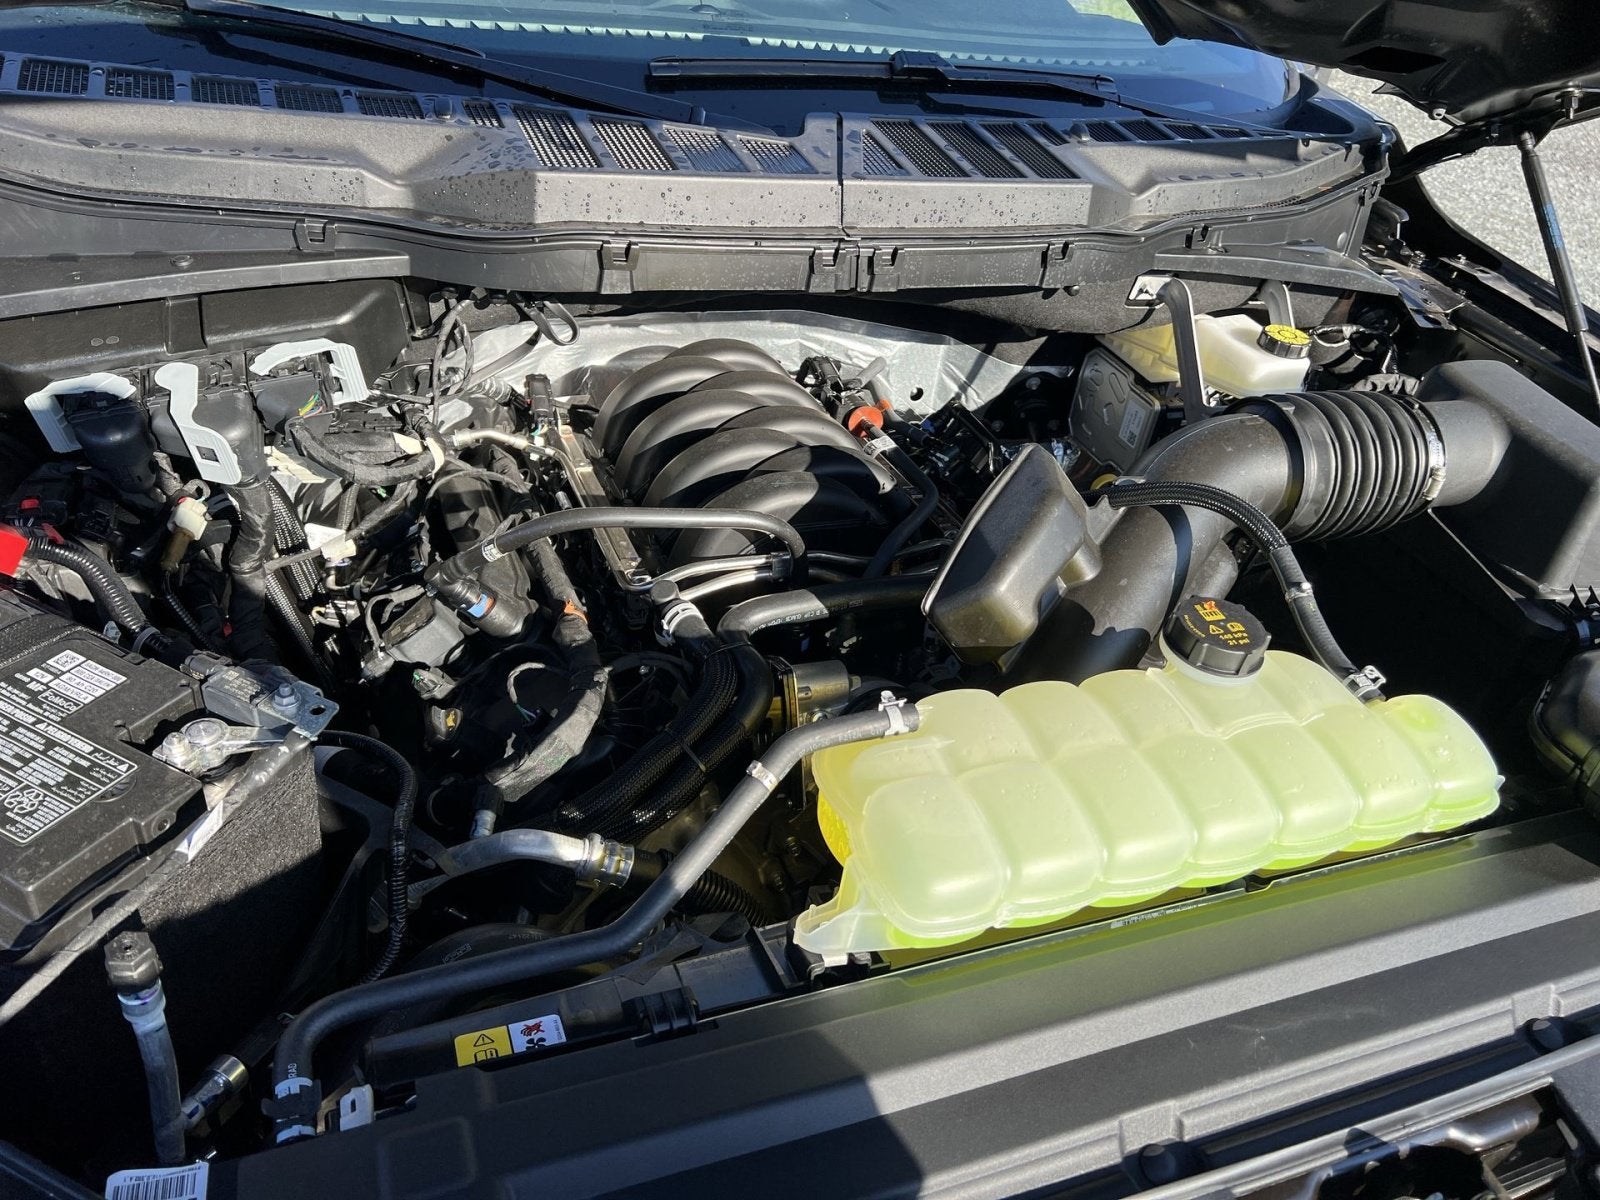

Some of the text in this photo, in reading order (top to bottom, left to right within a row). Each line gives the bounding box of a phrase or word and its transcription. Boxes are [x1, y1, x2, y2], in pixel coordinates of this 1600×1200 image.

[26, 681, 47, 692] MF
[43, 691, 78, 712] FoMoCo
[287, 1063, 297, 1078] RAD
